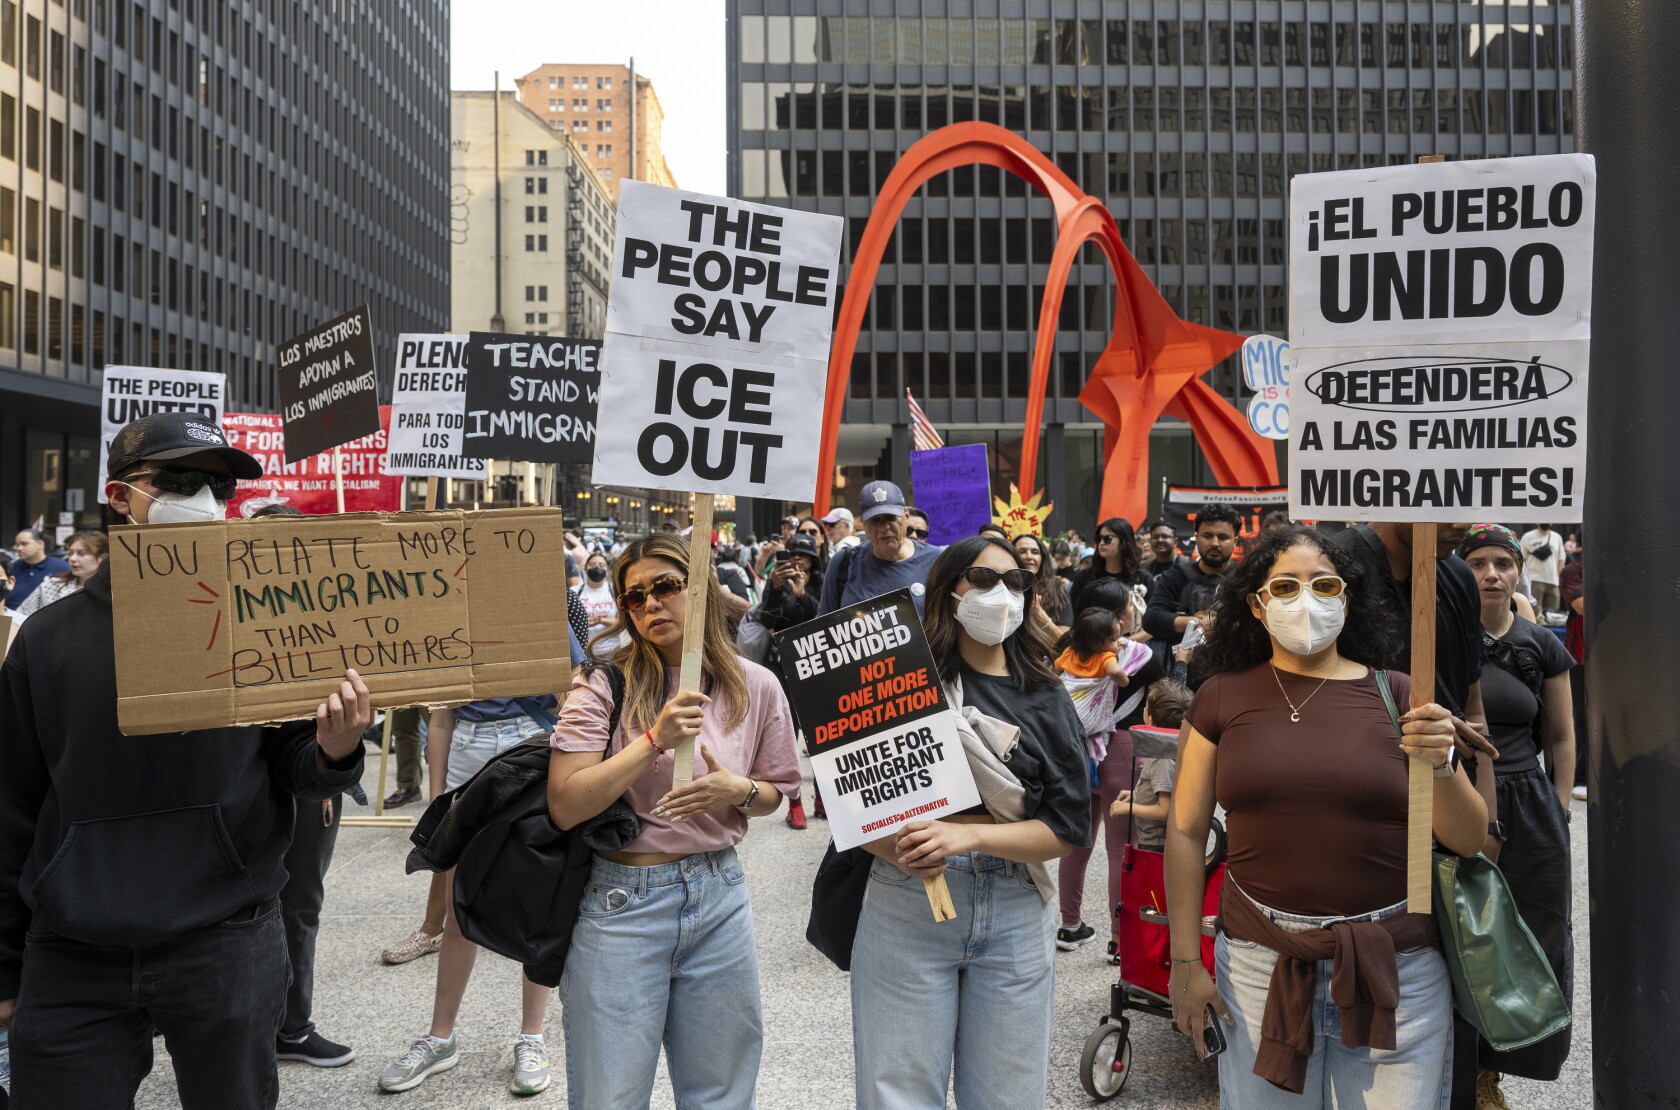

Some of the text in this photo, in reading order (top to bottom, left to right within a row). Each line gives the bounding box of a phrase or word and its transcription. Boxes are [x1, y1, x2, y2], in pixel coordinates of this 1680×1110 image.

[681, 200, 783, 255] THE
[1308, 181, 1583, 251] ¡EL PUEBLO
[621, 237, 829, 307] PEOPLE
[1320, 242, 1564, 323] UNIDO
[671, 293, 776, 343] SAY
[280, 315, 361, 367] LOS MAESTROS
[484, 342, 603, 372] TEACHE
[107, 378, 219, 399] THE PEOPLE
[299, 350, 355, 388] APOYAN A
[509, 376, 579, 403] STAND
[1321, 356, 1548, 405] DEFENDERÁ
[285, 370, 375, 423] LOS INMIGRANTES
[654, 359, 775, 426] ICE
[1262, 386, 1278, 399] IS
[185, 422, 212, 432] adidas
[246, 431, 285, 450] FOR
[398, 413, 463, 429] PARA TOD
[422, 433, 449, 449] LOS
[1299, 416, 1577, 450] A LAS FAMILIAS
[390, 453, 484, 471] INMIGRANTES
[637, 422, 783, 484] OUT
[285, 480, 299, 491] WE
[302, 480, 328, 491] WANT
[330, 480, 380, 491] SCIALISM!
[1300, 467, 1574, 507] MIGRANTES!
[1007, 507, 1027, 521] THE
[118, 528, 535, 581] YOU RELATE MORE TO
[234, 568, 449, 623] IMMIGRANTS
[255, 616, 400, 647] THAN TO
[793, 605, 900, 658] WE WON'T
[795, 625, 912, 681] BE DIVIDED
[232, 628, 474, 687] BILLIONARES
[860, 656, 896, 684] NOT
[838, 668, 928, 713] ONE MORE
[815, 686, 938, 745] DEPORTATION
[834, 742, 945, 796] IMMIGRANT
[835, 726, 935, 774] UNITE FOR
[860, 769, 933, 808] RIGHTS
[862, 797, 949, 834] SOCIALIST ALTERNATIVE
